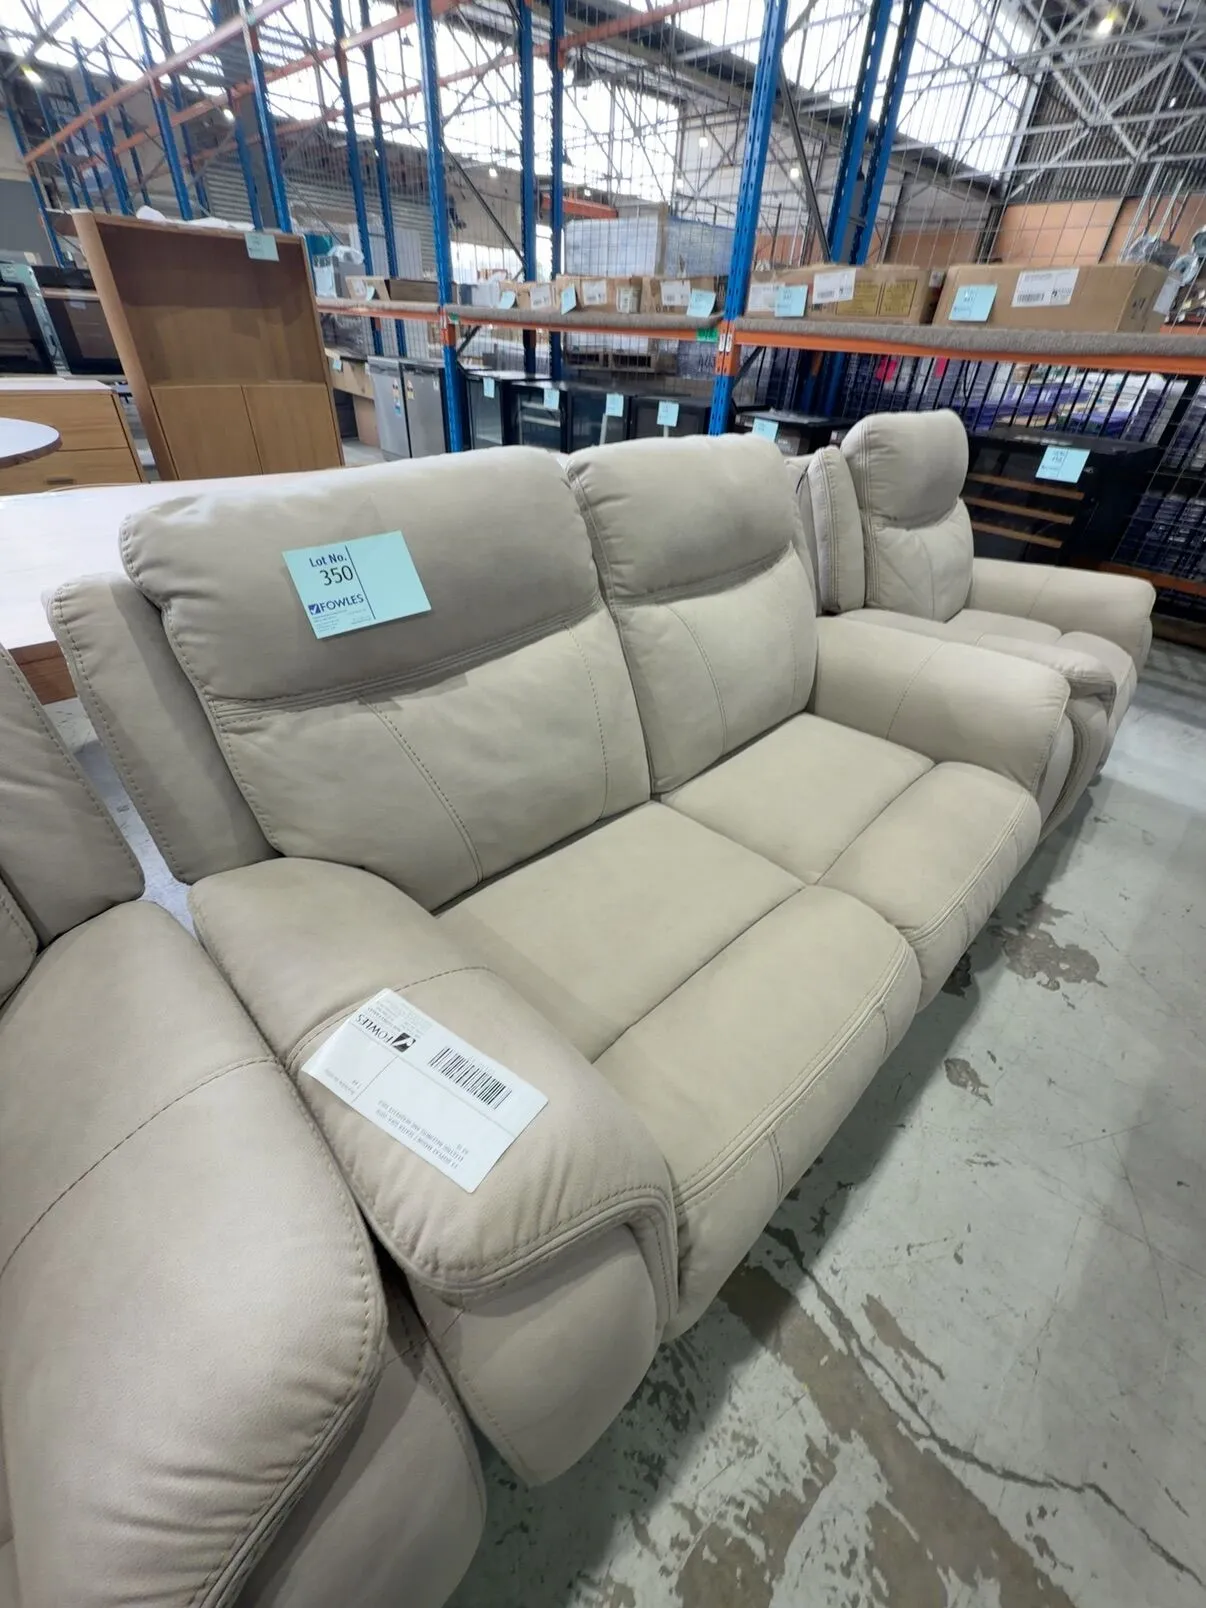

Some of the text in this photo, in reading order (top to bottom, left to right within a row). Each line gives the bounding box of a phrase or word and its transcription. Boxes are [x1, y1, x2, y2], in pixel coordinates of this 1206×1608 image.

[309, 553, 348, 568] Lot No.
[319, 565, 354, 586] 350
[320, 594, 364, 612] FOWLES
[355, 1013, 394, 1043] FOWLES
